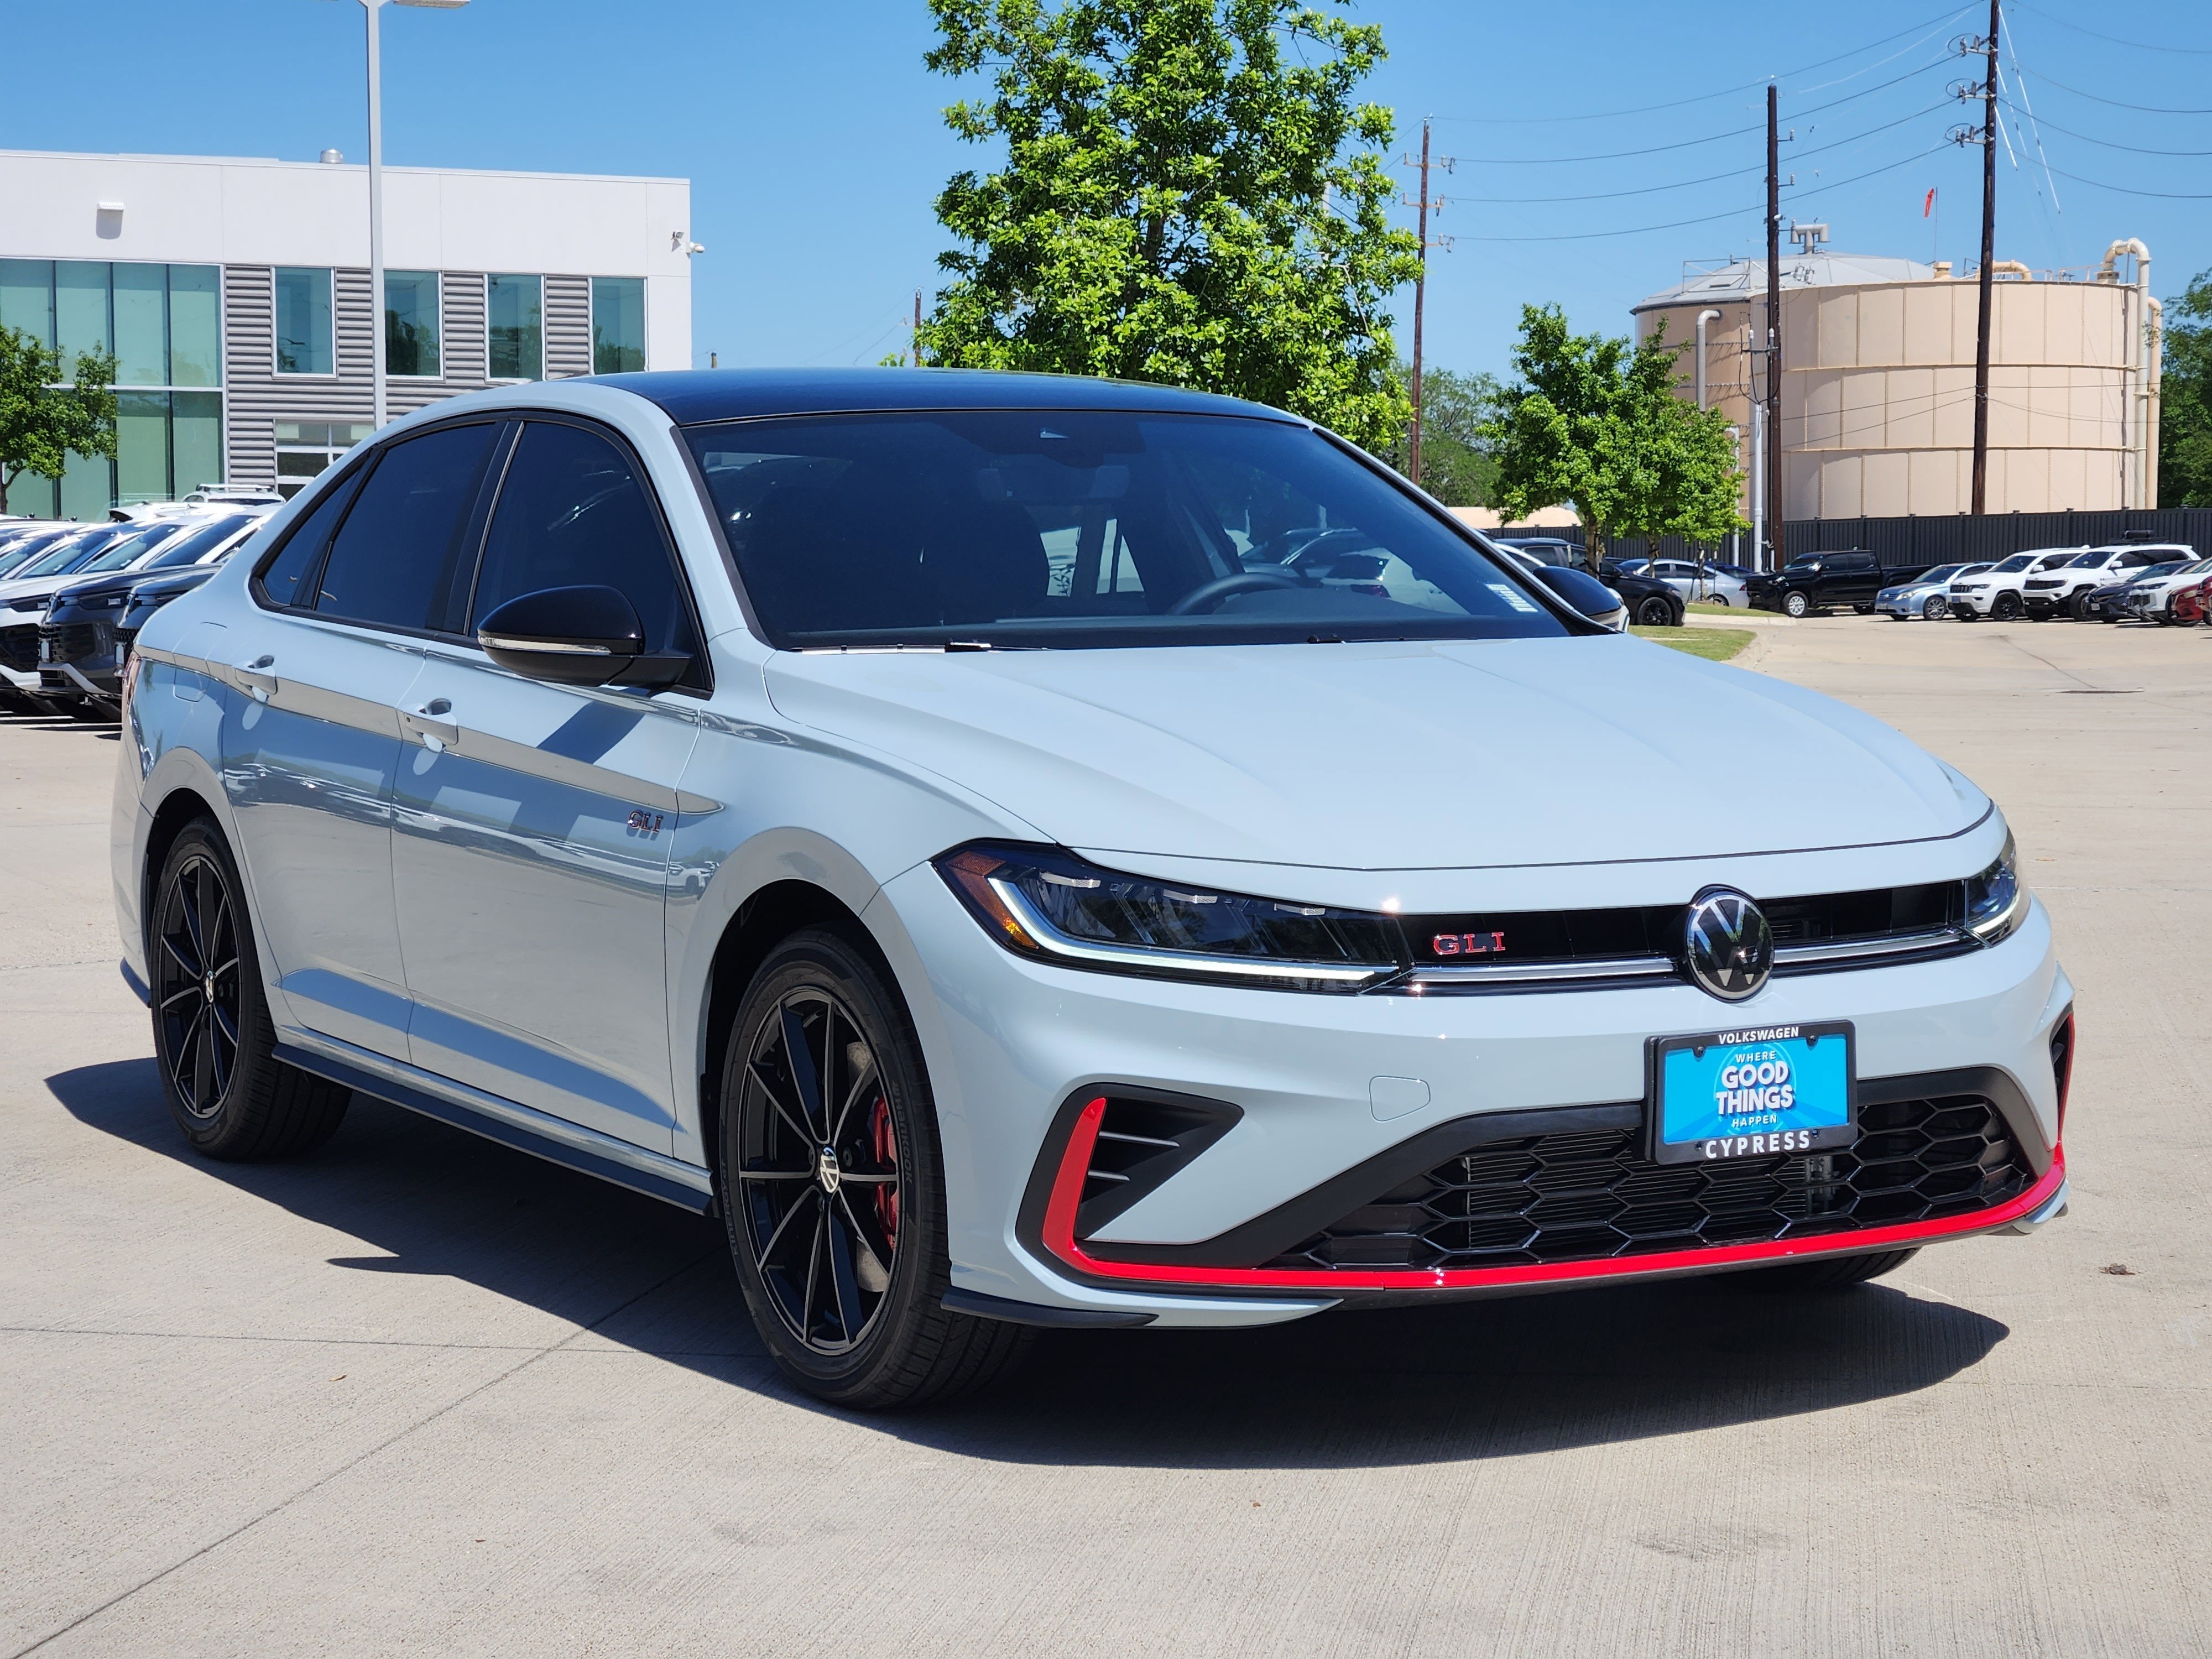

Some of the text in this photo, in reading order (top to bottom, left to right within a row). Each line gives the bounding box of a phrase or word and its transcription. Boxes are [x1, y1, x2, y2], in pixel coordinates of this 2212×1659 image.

[628, 810, 663, 833] GLI
[1433, 932, 1506, 956] GLI
[1718, 1026, 1799, 1045] VOLKSWAGEN
[1735, 1051, 1776, 1063] WHERE
[1721, 1061, 1789, 1089] GOOD
[1715, 1084, 1795, 1115] THINGS
[1732, 1114, 1778, 1128] HAPPEN
[1705, 1130, 1810, 1160] CYPRESS
